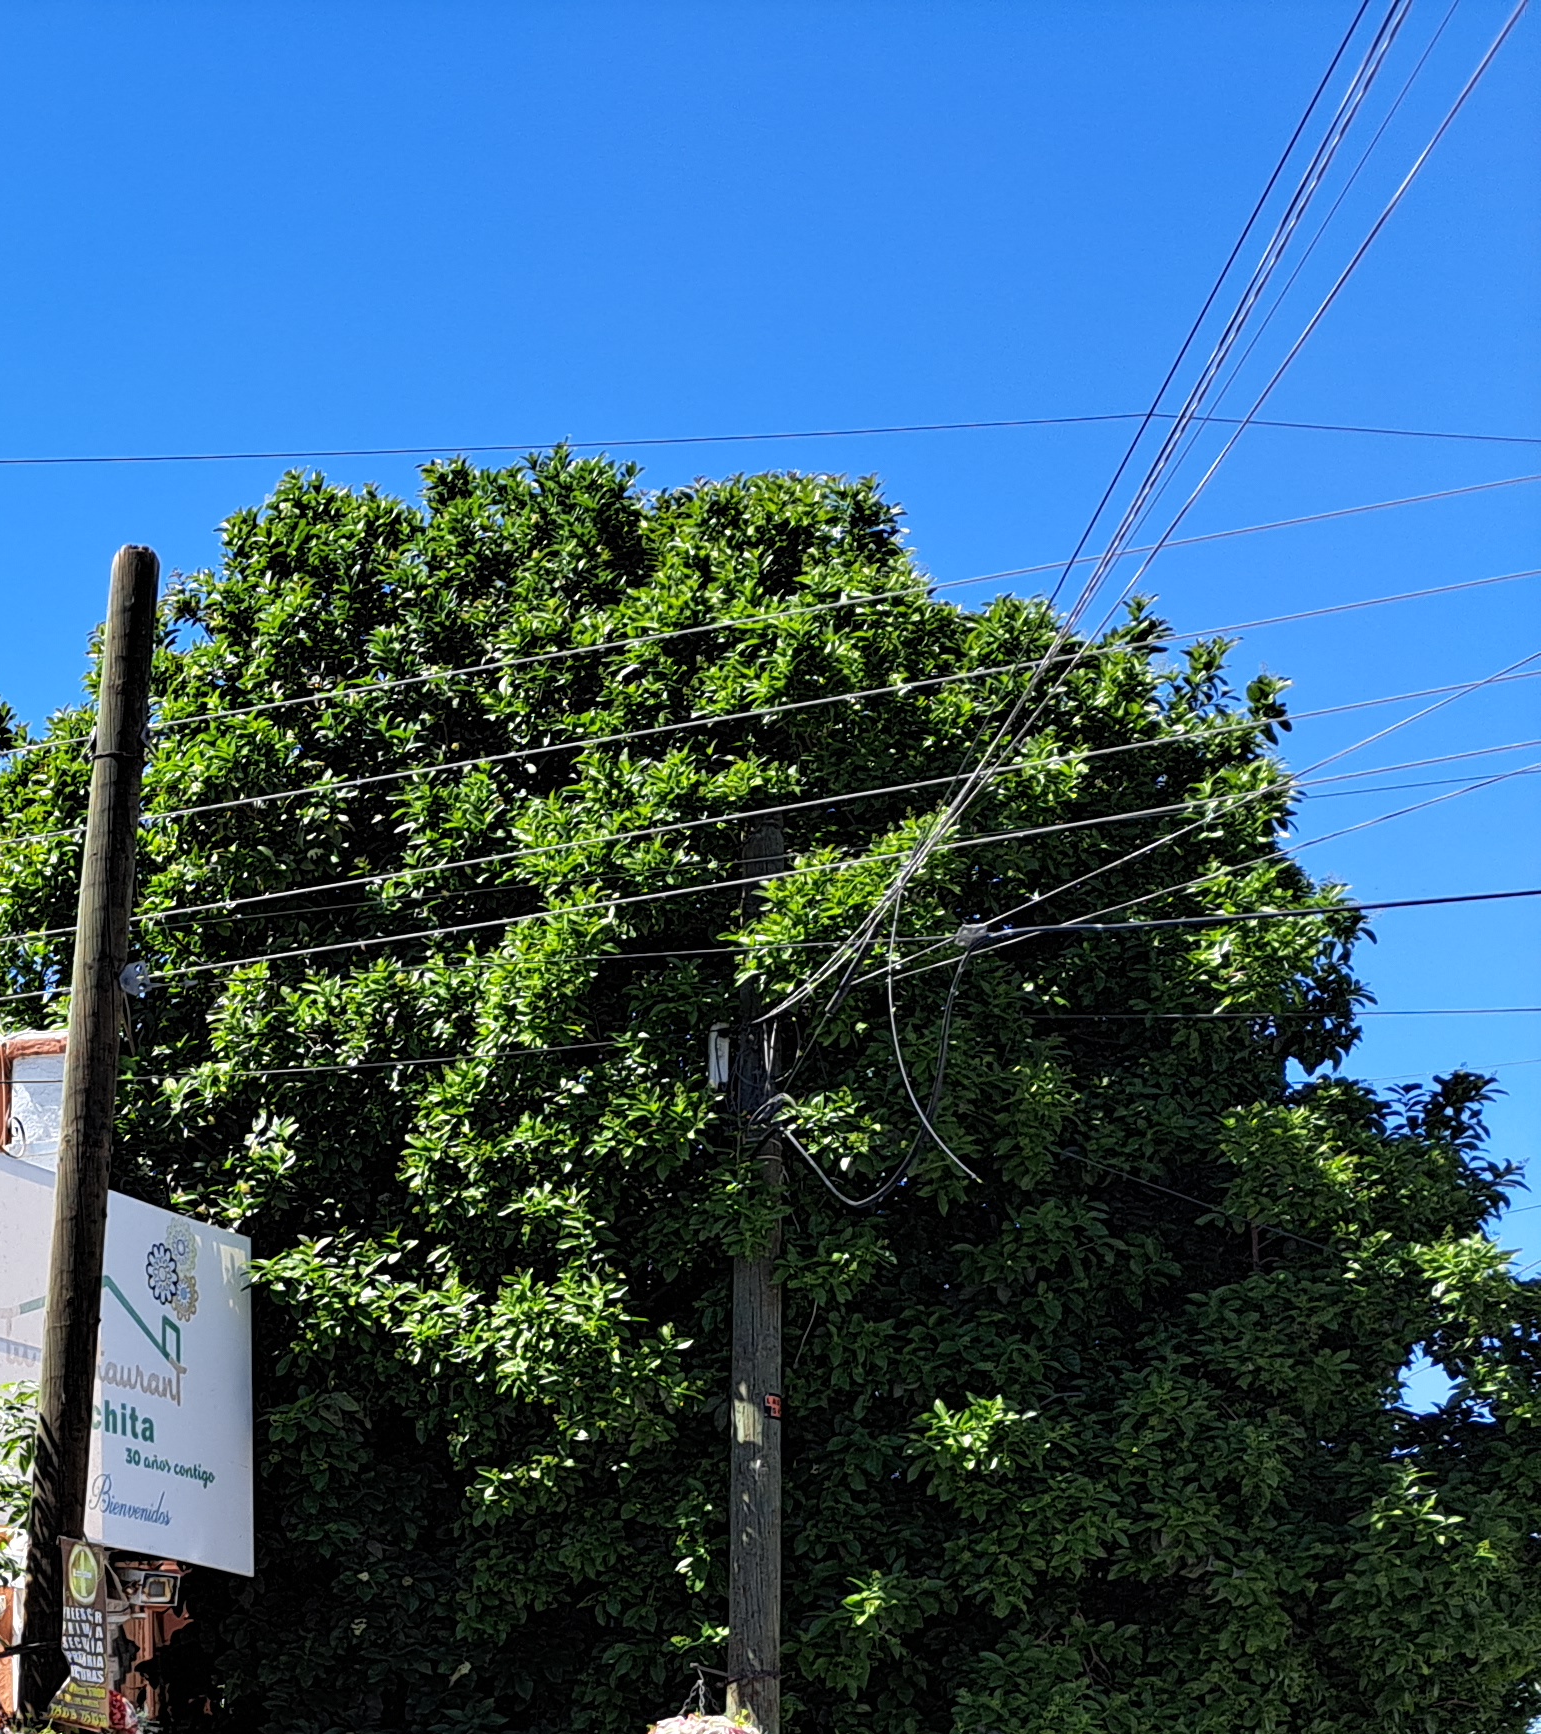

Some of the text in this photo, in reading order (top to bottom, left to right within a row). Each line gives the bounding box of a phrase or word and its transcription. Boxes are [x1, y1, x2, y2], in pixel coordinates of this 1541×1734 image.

[125, 1447, 215, 1489] 30 años contigo
[89, 1473, 172, 1527] Bienvenidos
